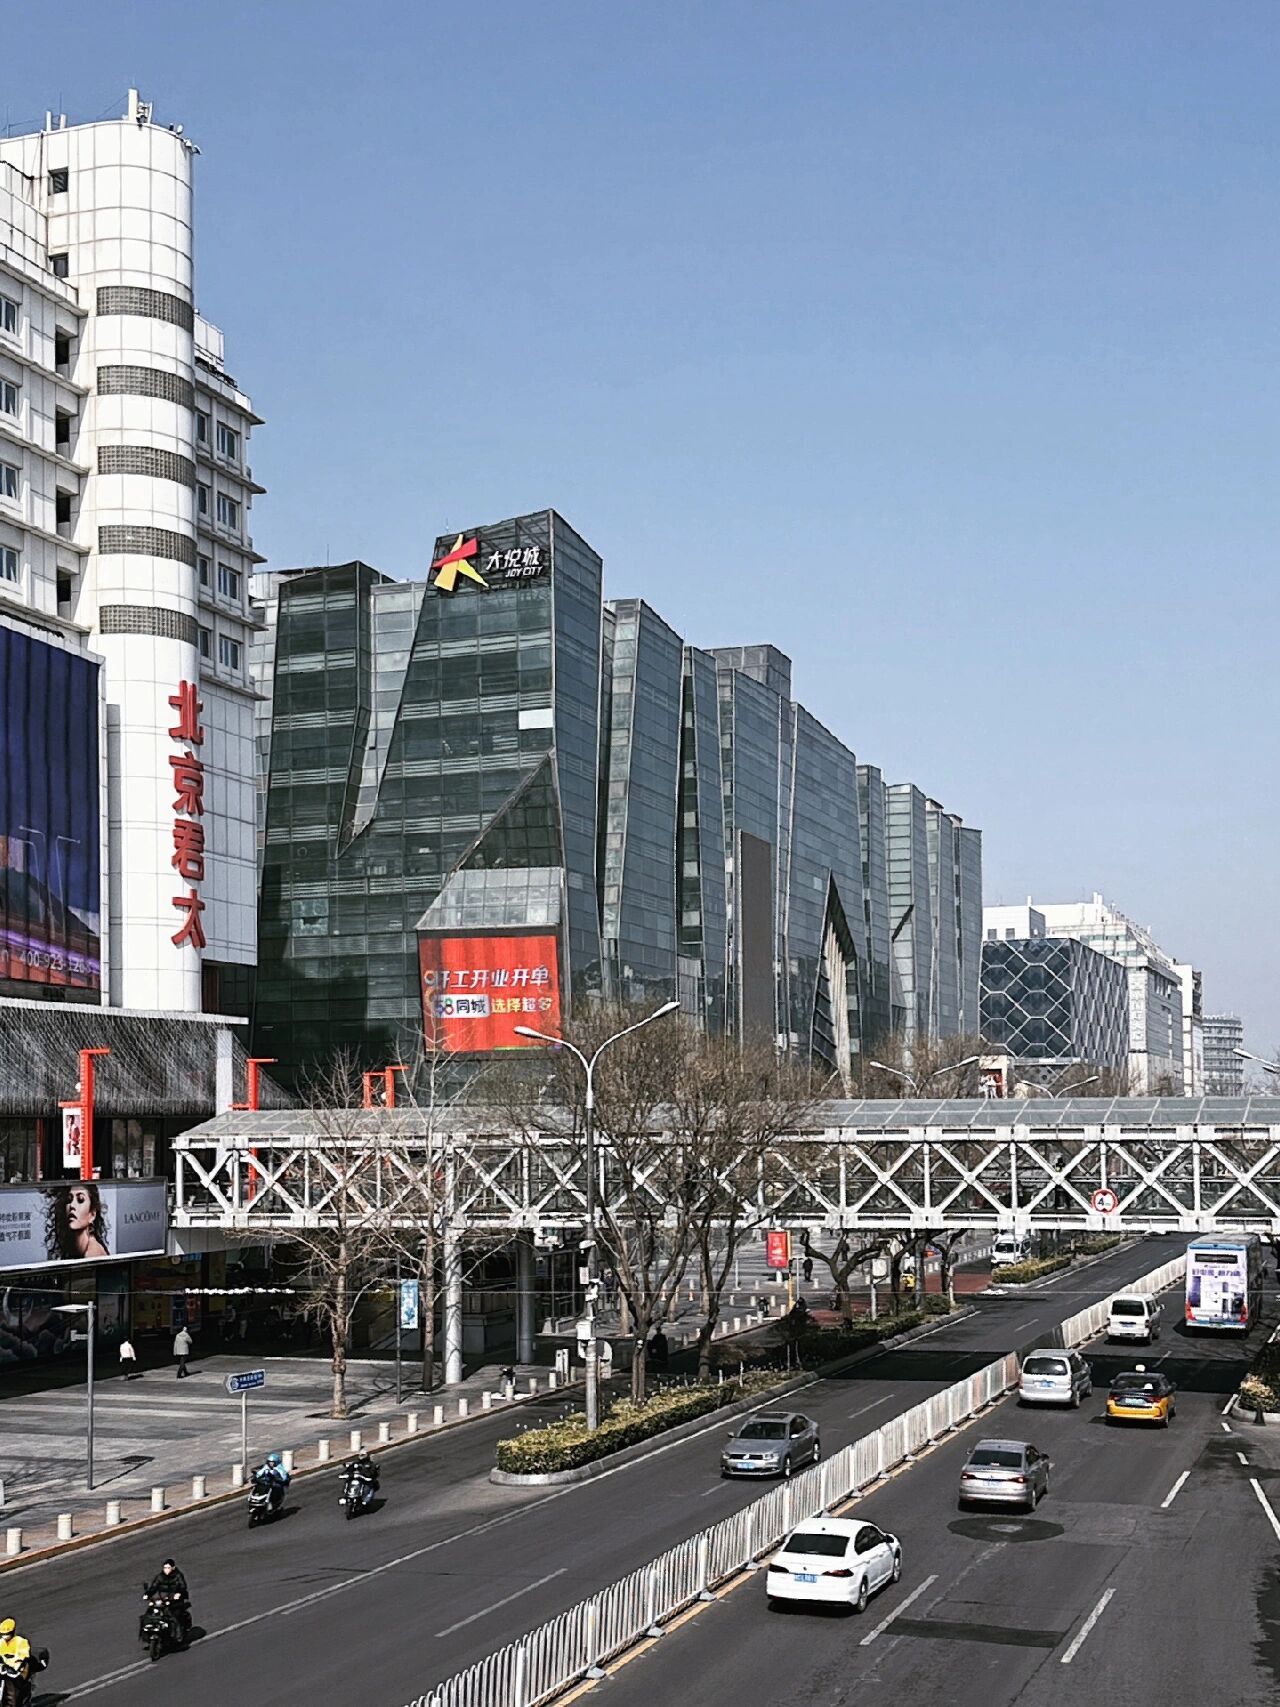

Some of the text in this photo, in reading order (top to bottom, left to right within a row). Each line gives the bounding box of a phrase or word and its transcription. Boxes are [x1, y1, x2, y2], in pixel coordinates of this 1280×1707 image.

[485, 546, 540, 571] 大悦城
[505, 565, 544, 578] JOY CITY
[168, 679, 207, 949] 北京君太
[436, 965, 549, 989] 开工开业开单
